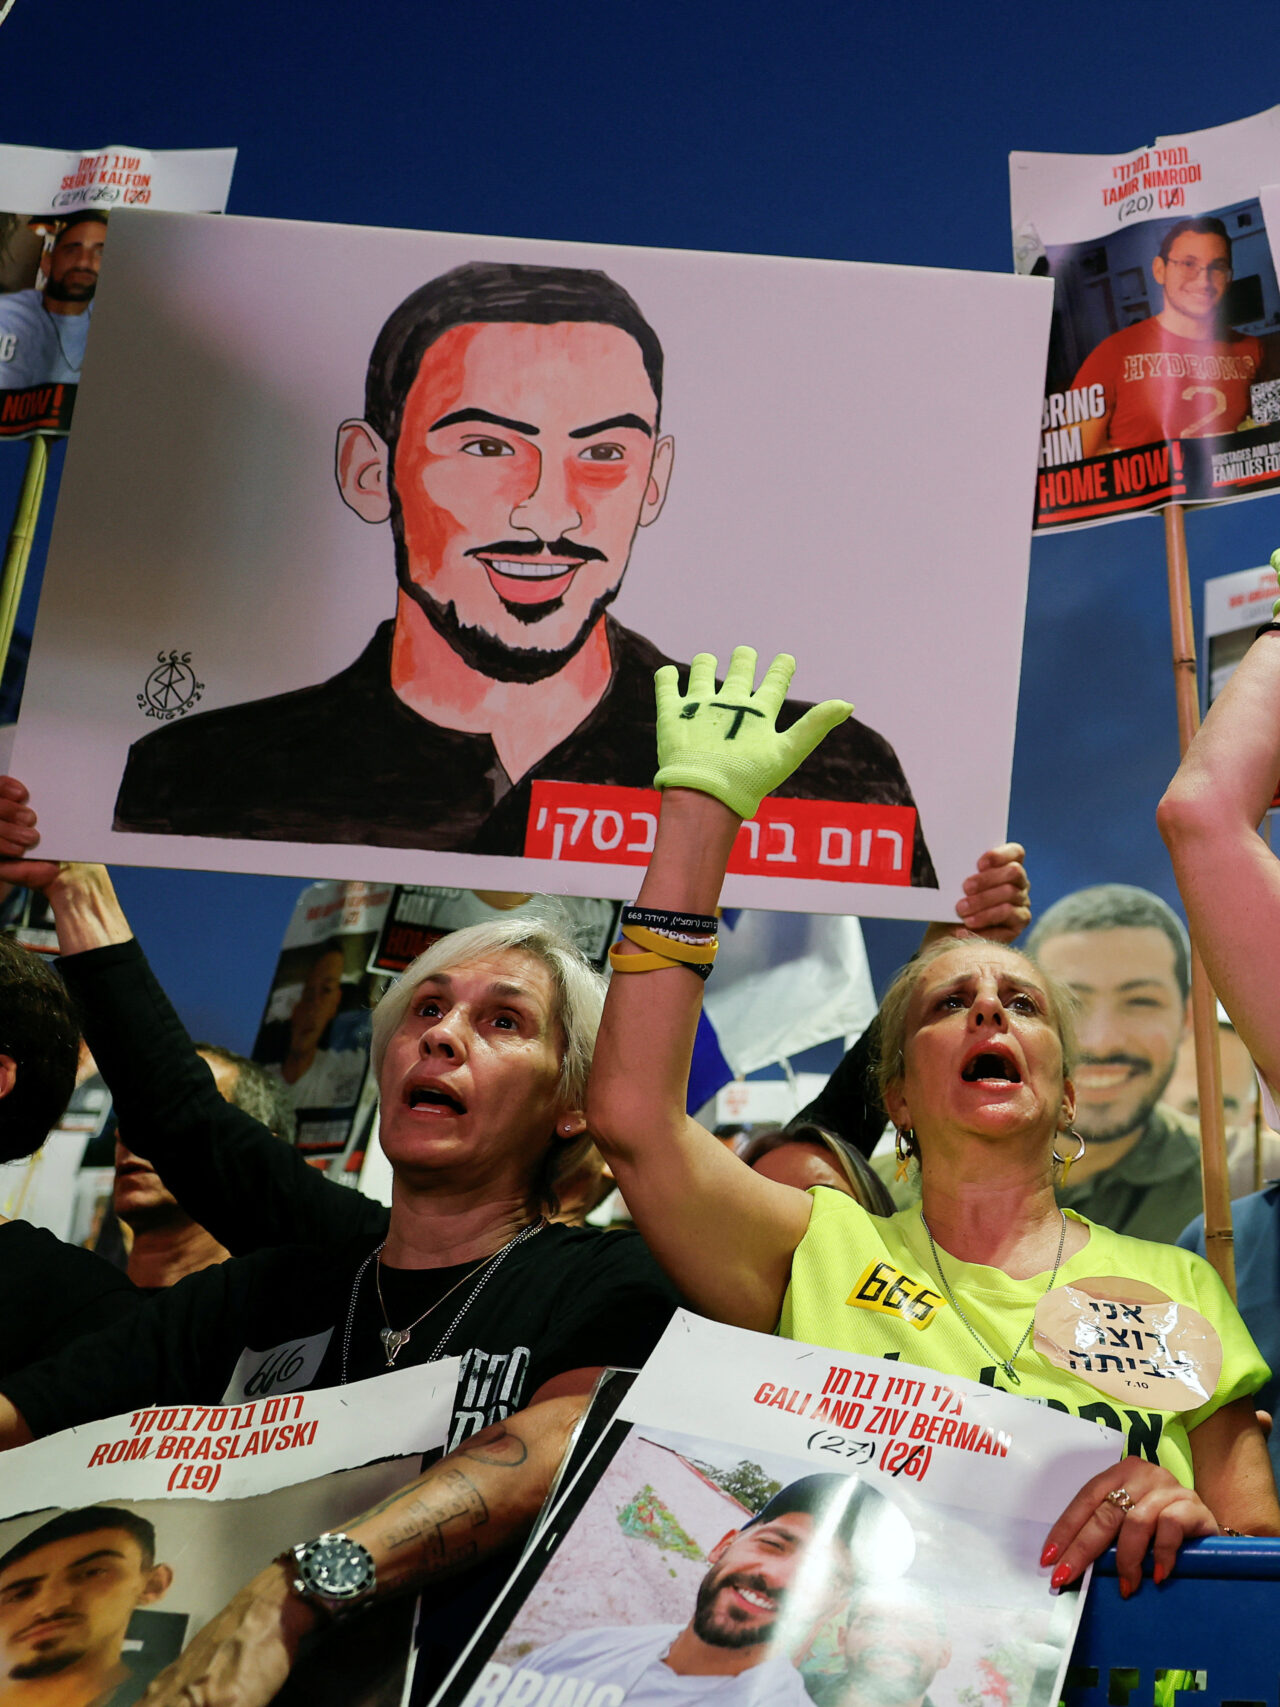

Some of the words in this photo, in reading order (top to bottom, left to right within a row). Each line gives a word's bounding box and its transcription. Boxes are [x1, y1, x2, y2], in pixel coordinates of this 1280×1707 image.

[1112, 152, 1150, 182] נמרודי
[1154, 146, 1189, 167] תמיר
[98, 170, 152, 187] KALFON
[1102, 177, 1139, 207] TAMIR
[1143, 163, 1202, 190] NIMRODI
[1118, 193, 1154, 221] (20)
[1039, 462, 1108, 511] HOME
[1115, 440, 1185, 497] NOW!
[1212, 457, 1263, 484] FAMILIES
[156, 649, 192, 663] 666
[145, 707, 176, 720] AUG
[678, 701, 766, 740] די
[818, 826, 903, 871] רום
[644, 913, 668, 923] יחידה
[859, 1261, 940, 1322] 666
[1088, 1302, 1145, 1324] אני
[820, 1366, 876, 1400] ברמן
[883, 1375, 926, 1407] וזיו
[1124, 1380, 1149, 1389] 7.10
[262, 1394, 305, 1423] רום
[931, 1384, 968, 1417] גלי
[129, 1405, 253, 1436] ברסלבסקי
[753, 1381, 812, 1418] GALI
[813, 1397, 866, 1433] AND
[865, 1404, 909, 1439] ZIV
[908, 1410, 1013, 1458] BERMAN
[87, 1437, 152, 1469] ROM
[156, 1420, 319, 1461] BRASLAVSKI
[806, 1429, 877, 1466] (27)
[166, 1462, 222, 1495] (19)
